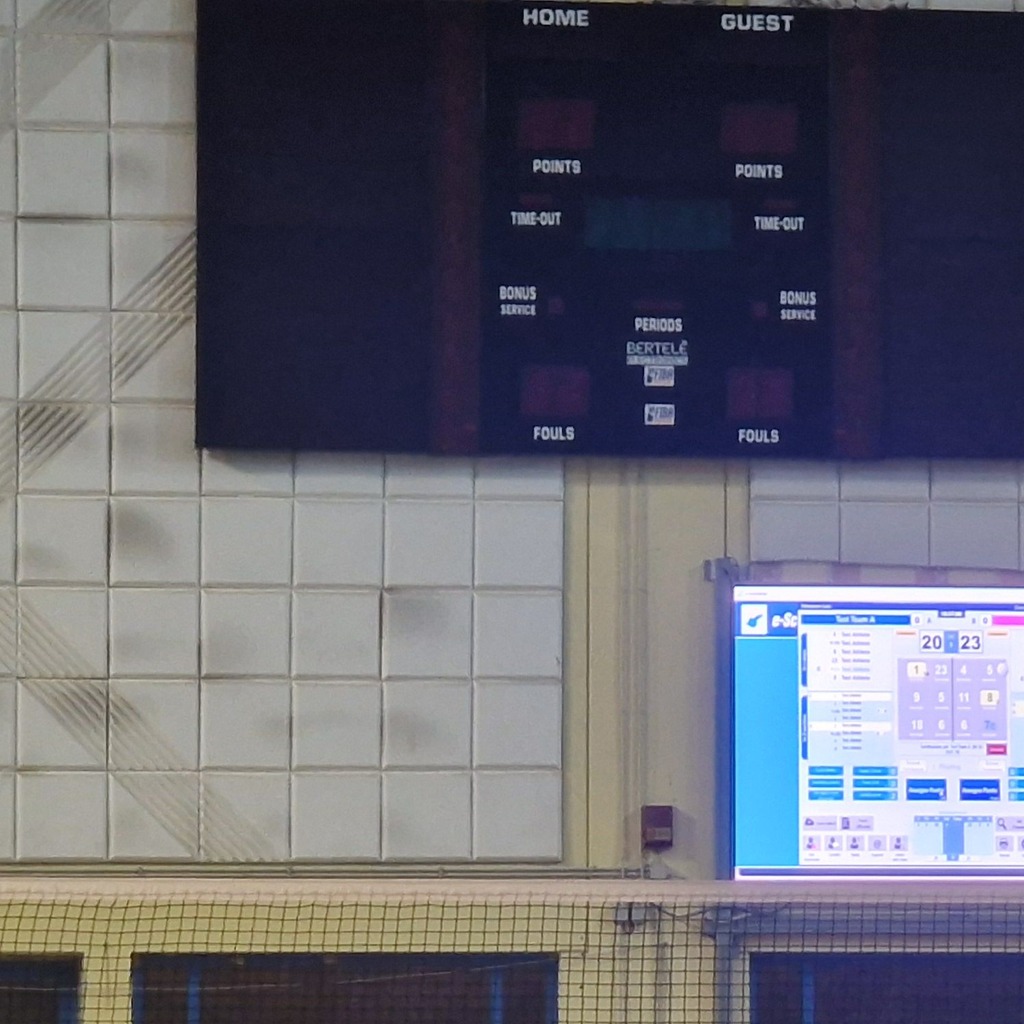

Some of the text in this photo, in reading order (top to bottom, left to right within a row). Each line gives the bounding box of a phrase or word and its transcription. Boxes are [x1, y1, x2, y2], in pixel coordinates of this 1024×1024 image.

[522, 8, 589, 27] HOME
[720, 13, 794, 32] GUEST
[532, 158, 581, 174] POINTS
[735, 163, 783, 179] POINTS
[510, 211, 562, 226] TIME-OUT
[754, 215, 805, 231] TIME-OUT
[499, 285, 537, 301] BONUS
[779, 290, 817, 306] BONUS
[500, 303, 536, 316] SERVICE
[780, 308, 817, 321] SERVICE
[634, 317, 683, 332] PERIODS
[533, 426, 575, 441] FOULS
[738, 428, 780, 443] FOULS
[922, 635, 942, 650] 20
[960, 635, 981, 650] 23
[914, 664, 920, 674] 1
[934, 664, 948, 675] 23
[960, 664, 967, 675] 4
[958, 692, 970, 703] 11
[986, 692, 994, 703] 8
